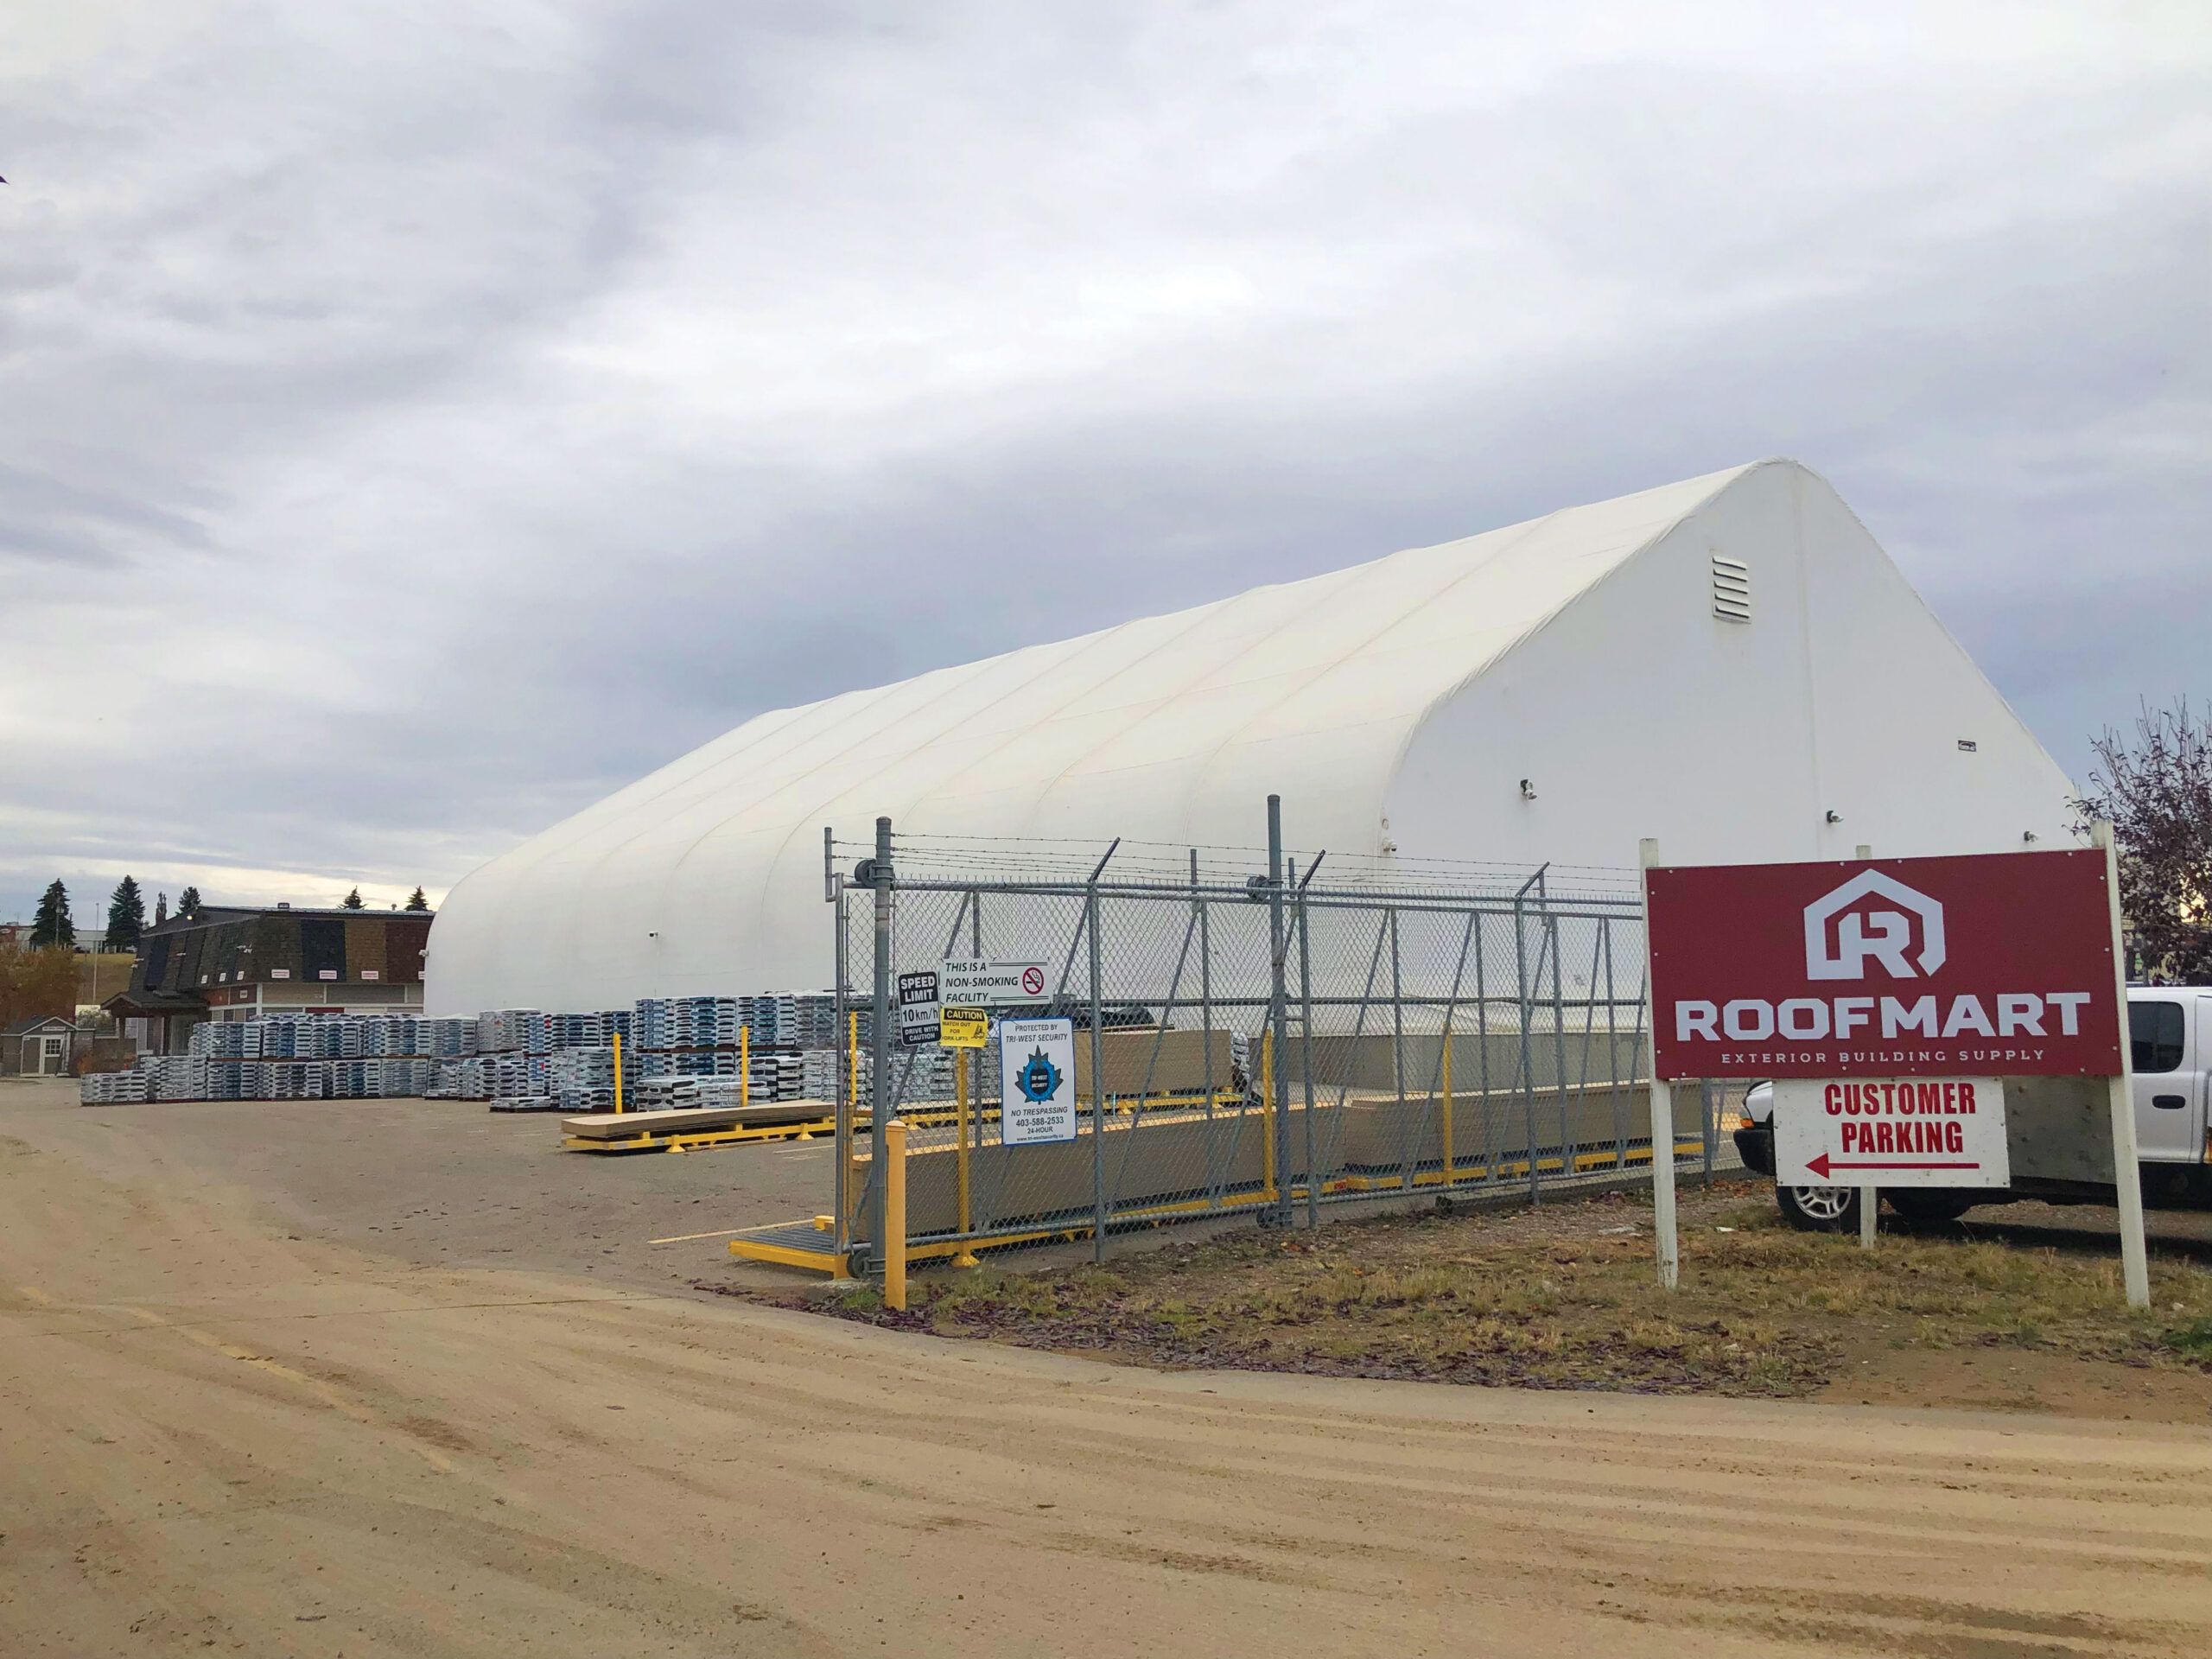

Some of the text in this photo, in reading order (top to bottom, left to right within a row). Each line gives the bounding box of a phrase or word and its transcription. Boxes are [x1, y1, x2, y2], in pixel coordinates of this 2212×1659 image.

[945, 962, 987, 972] THIS IS A
[900, 976, 936, 990] SPEED
[945, 976, 1019, 988] NON-SMOKING
[905, 988, 933, 1002] LIMIT
[945, 992, 988, 1002] FACILITY
[946, 1010, 982, 1020] CAUTION
[1675, 992, 2091, 1041] ROOFMART
[905, 1027, 923, 1035] DRIVE
[909, 1033, 935, 1041] CAUTION
[1006, 1033, 1068, 1043] TRI-WEST SECURITY
[1721, 1049, 2045, 1065] EXTERIOR BUILDING SUPPLY
[1824, 1083, 1976, 1116] CUSTOMER
[1023, 1106, 1068, 1116] TRESPASSING
[1016, 1116, 1065, 1127] 403-588-2533
[1840, 1121, 1963, 1154] PARKING
